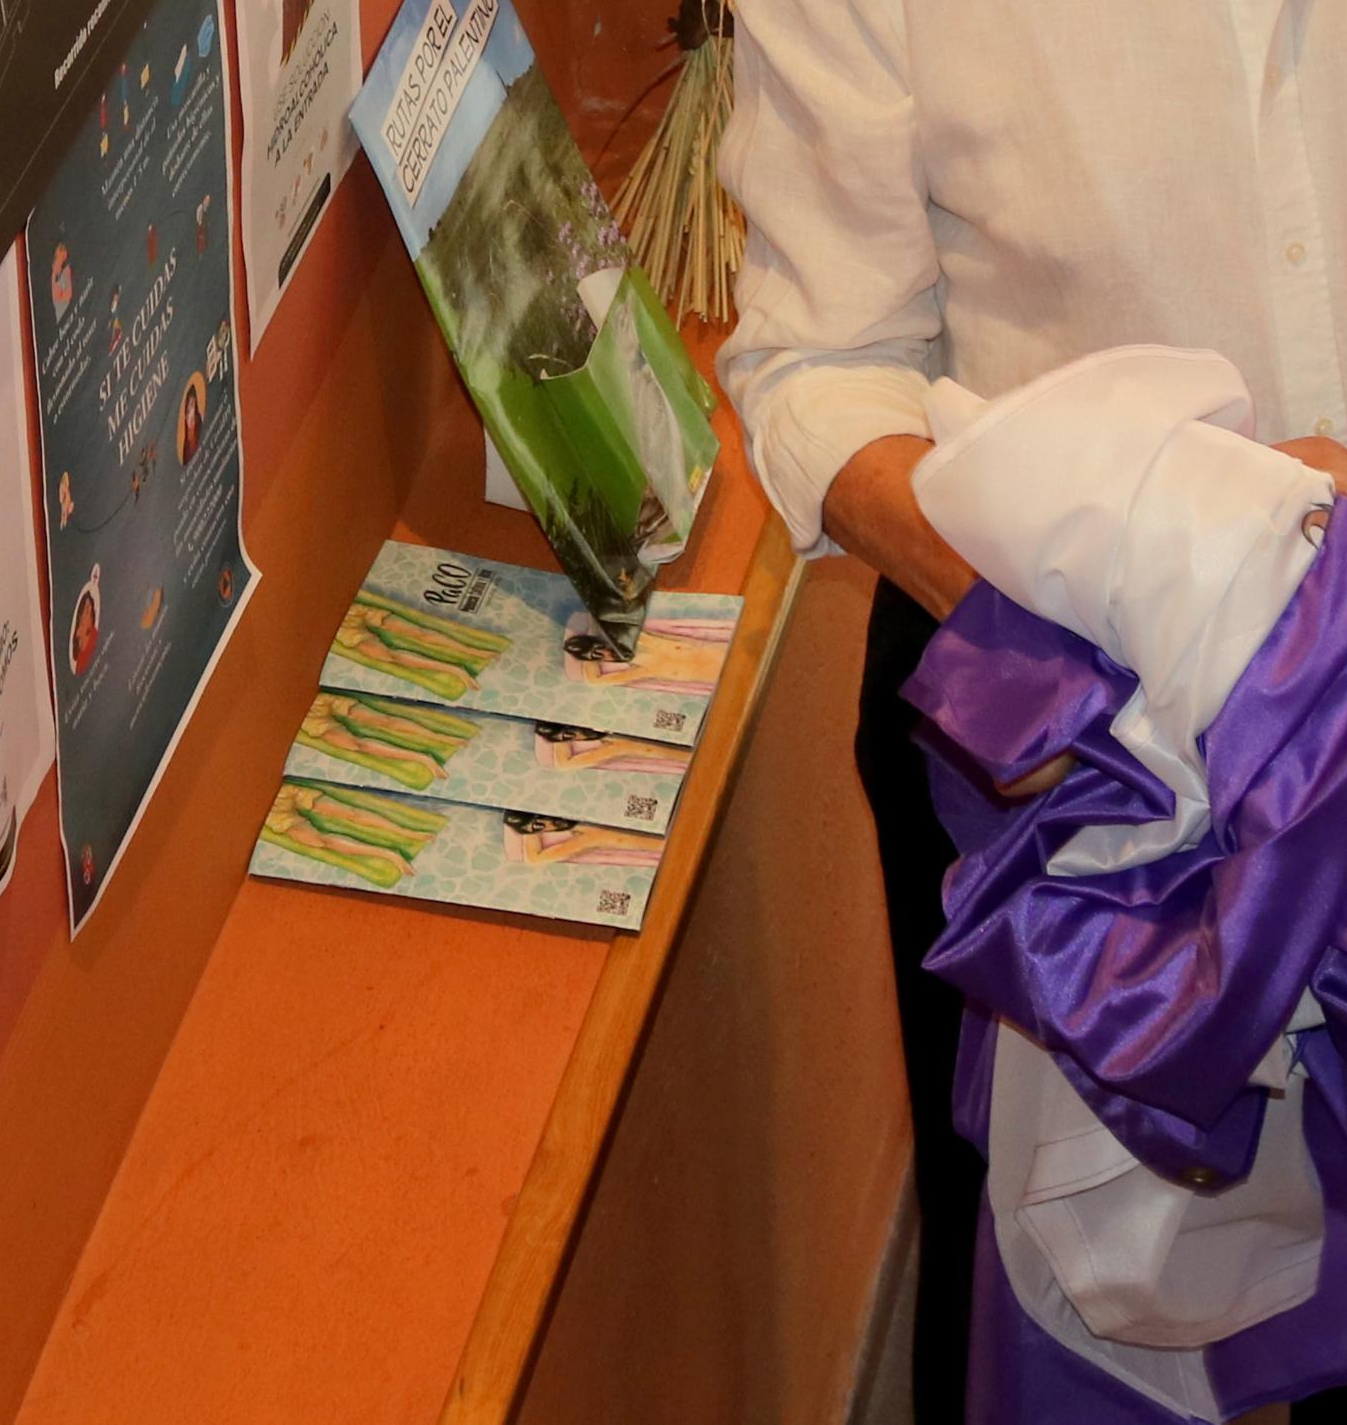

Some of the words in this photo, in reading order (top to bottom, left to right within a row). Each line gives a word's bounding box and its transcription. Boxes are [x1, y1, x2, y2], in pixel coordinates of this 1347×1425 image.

[55, 26, 87, 91] Recorrido
[281, 128, 293, 155] LA
[292, 62, 330, 133] ENTRADA
[386, 74, 421, 157] RUTAS
[414, 26, 442, 82] POR
[433, 4, 453, 36] EL
[402, 88, 448, 194] CERRATO
[99, 373, 112, 411] SI
[112, 336, 132, 384] TE
[132, 246, 178, 347] CUIDAS
[107, 388, 129, 443] ME
[129, 296, 174, 398] CUIDAS
[117, 350, 170, 466] HIGIENE
